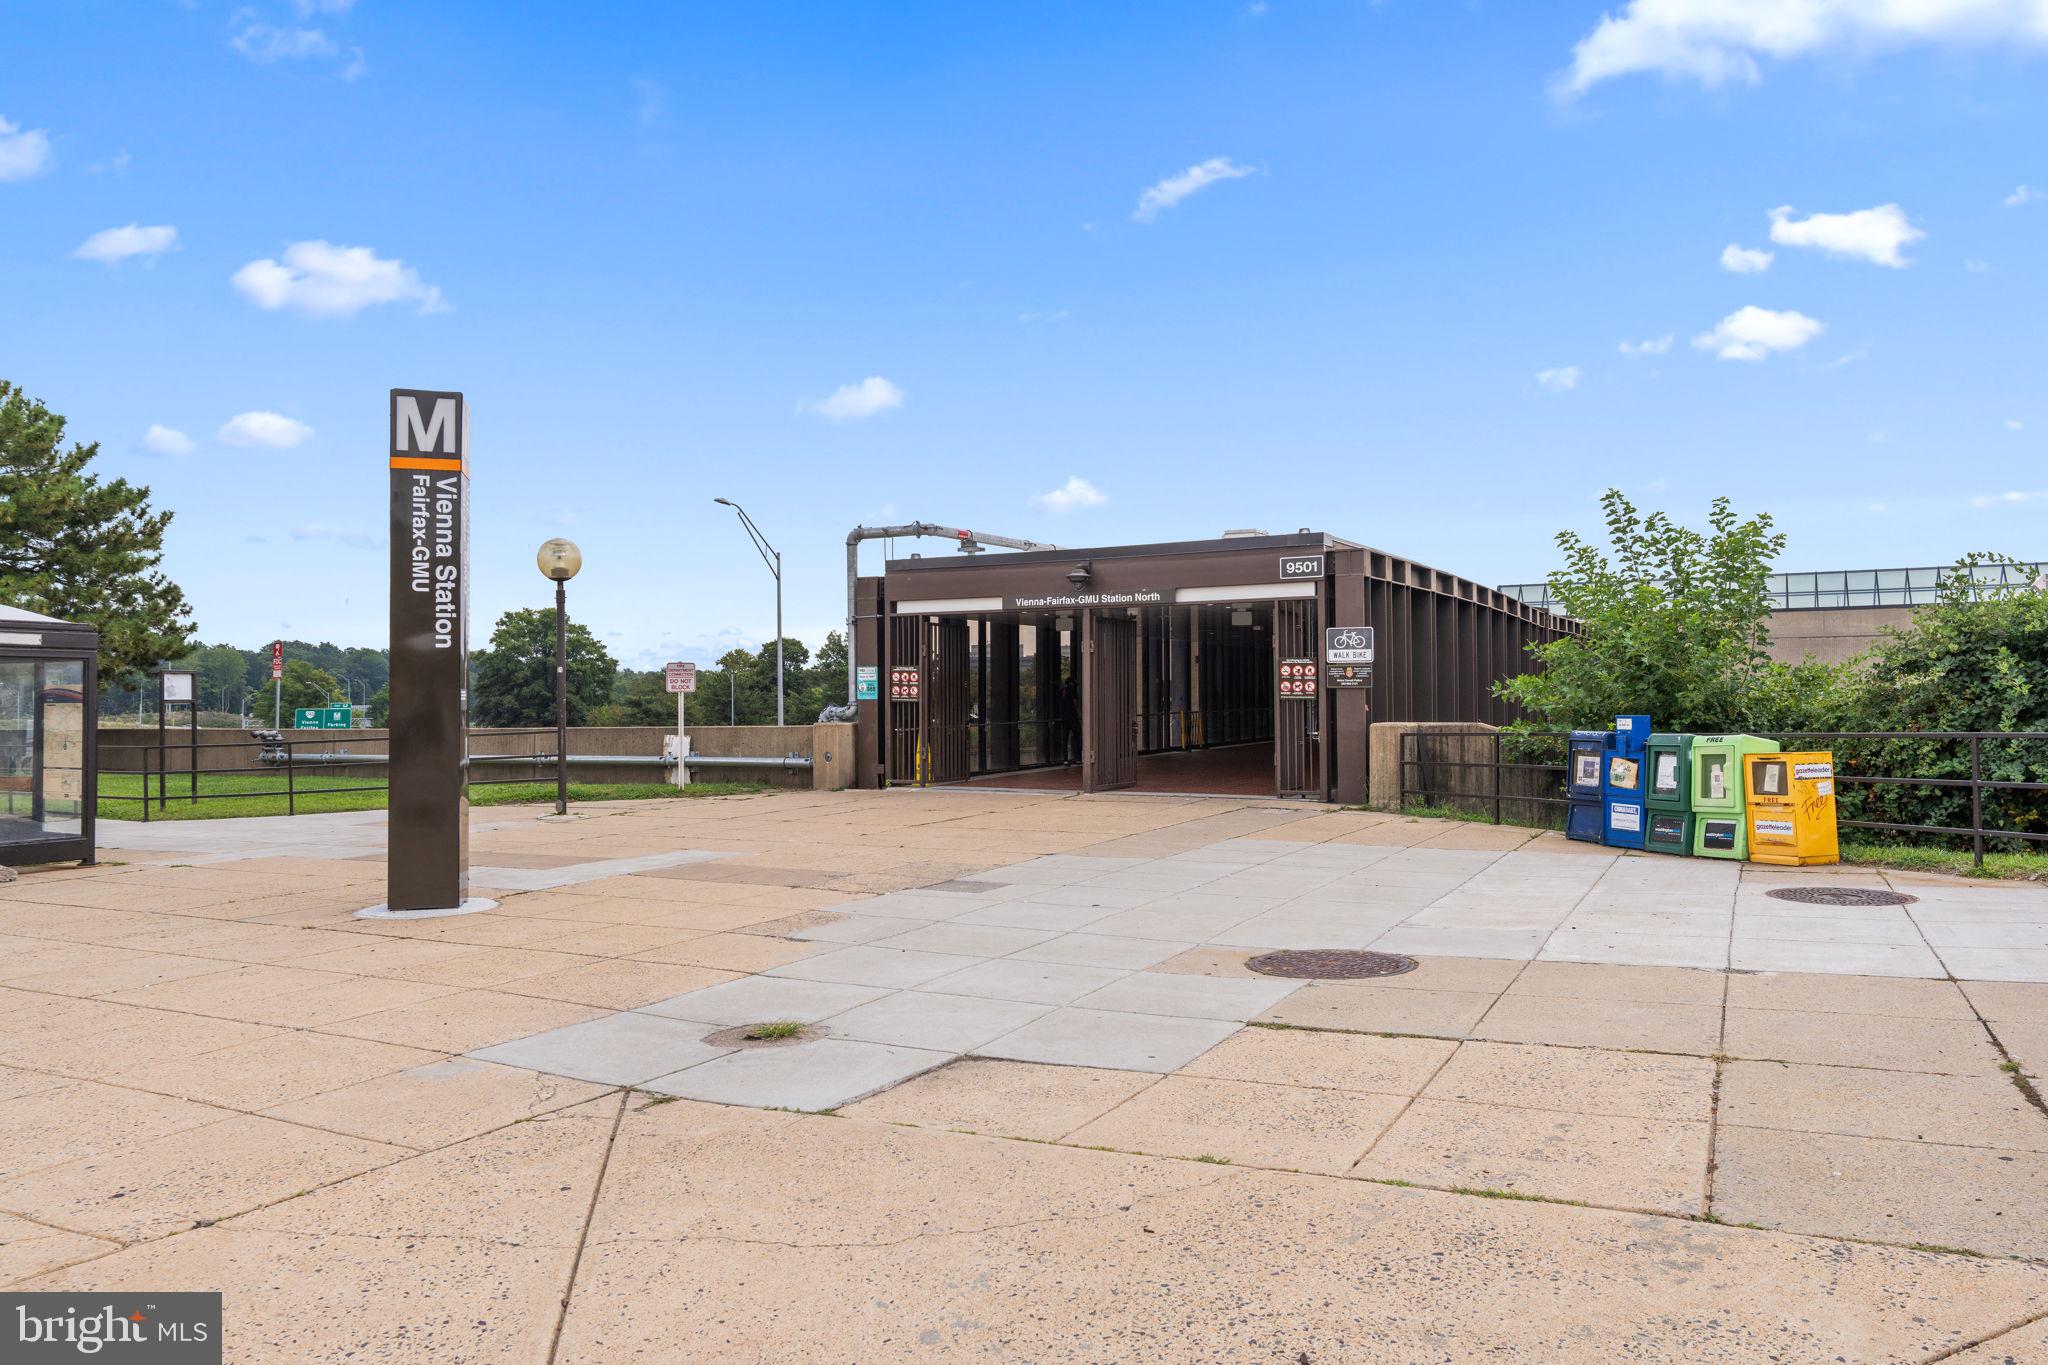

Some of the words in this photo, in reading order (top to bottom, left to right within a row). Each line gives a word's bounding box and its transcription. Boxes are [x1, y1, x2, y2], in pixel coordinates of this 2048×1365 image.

[396, 396, 456, 453] M
[411, 474, 430, 592] Fairfax-GMU
[436, 477, 458, 557] Vienna
[1286, 560, 1318, 574] 9501
[435, 565, 458, 649] Station
[1015, 595, 1099, 607] Vienna-Fairfax-GMU
[1101, 593, 1133, 603] Station
[1135, 592, 1160, 601] North
[1755, 823, 1793, 832] gazetteleader
[1801, 795, 1828, 821] Free
